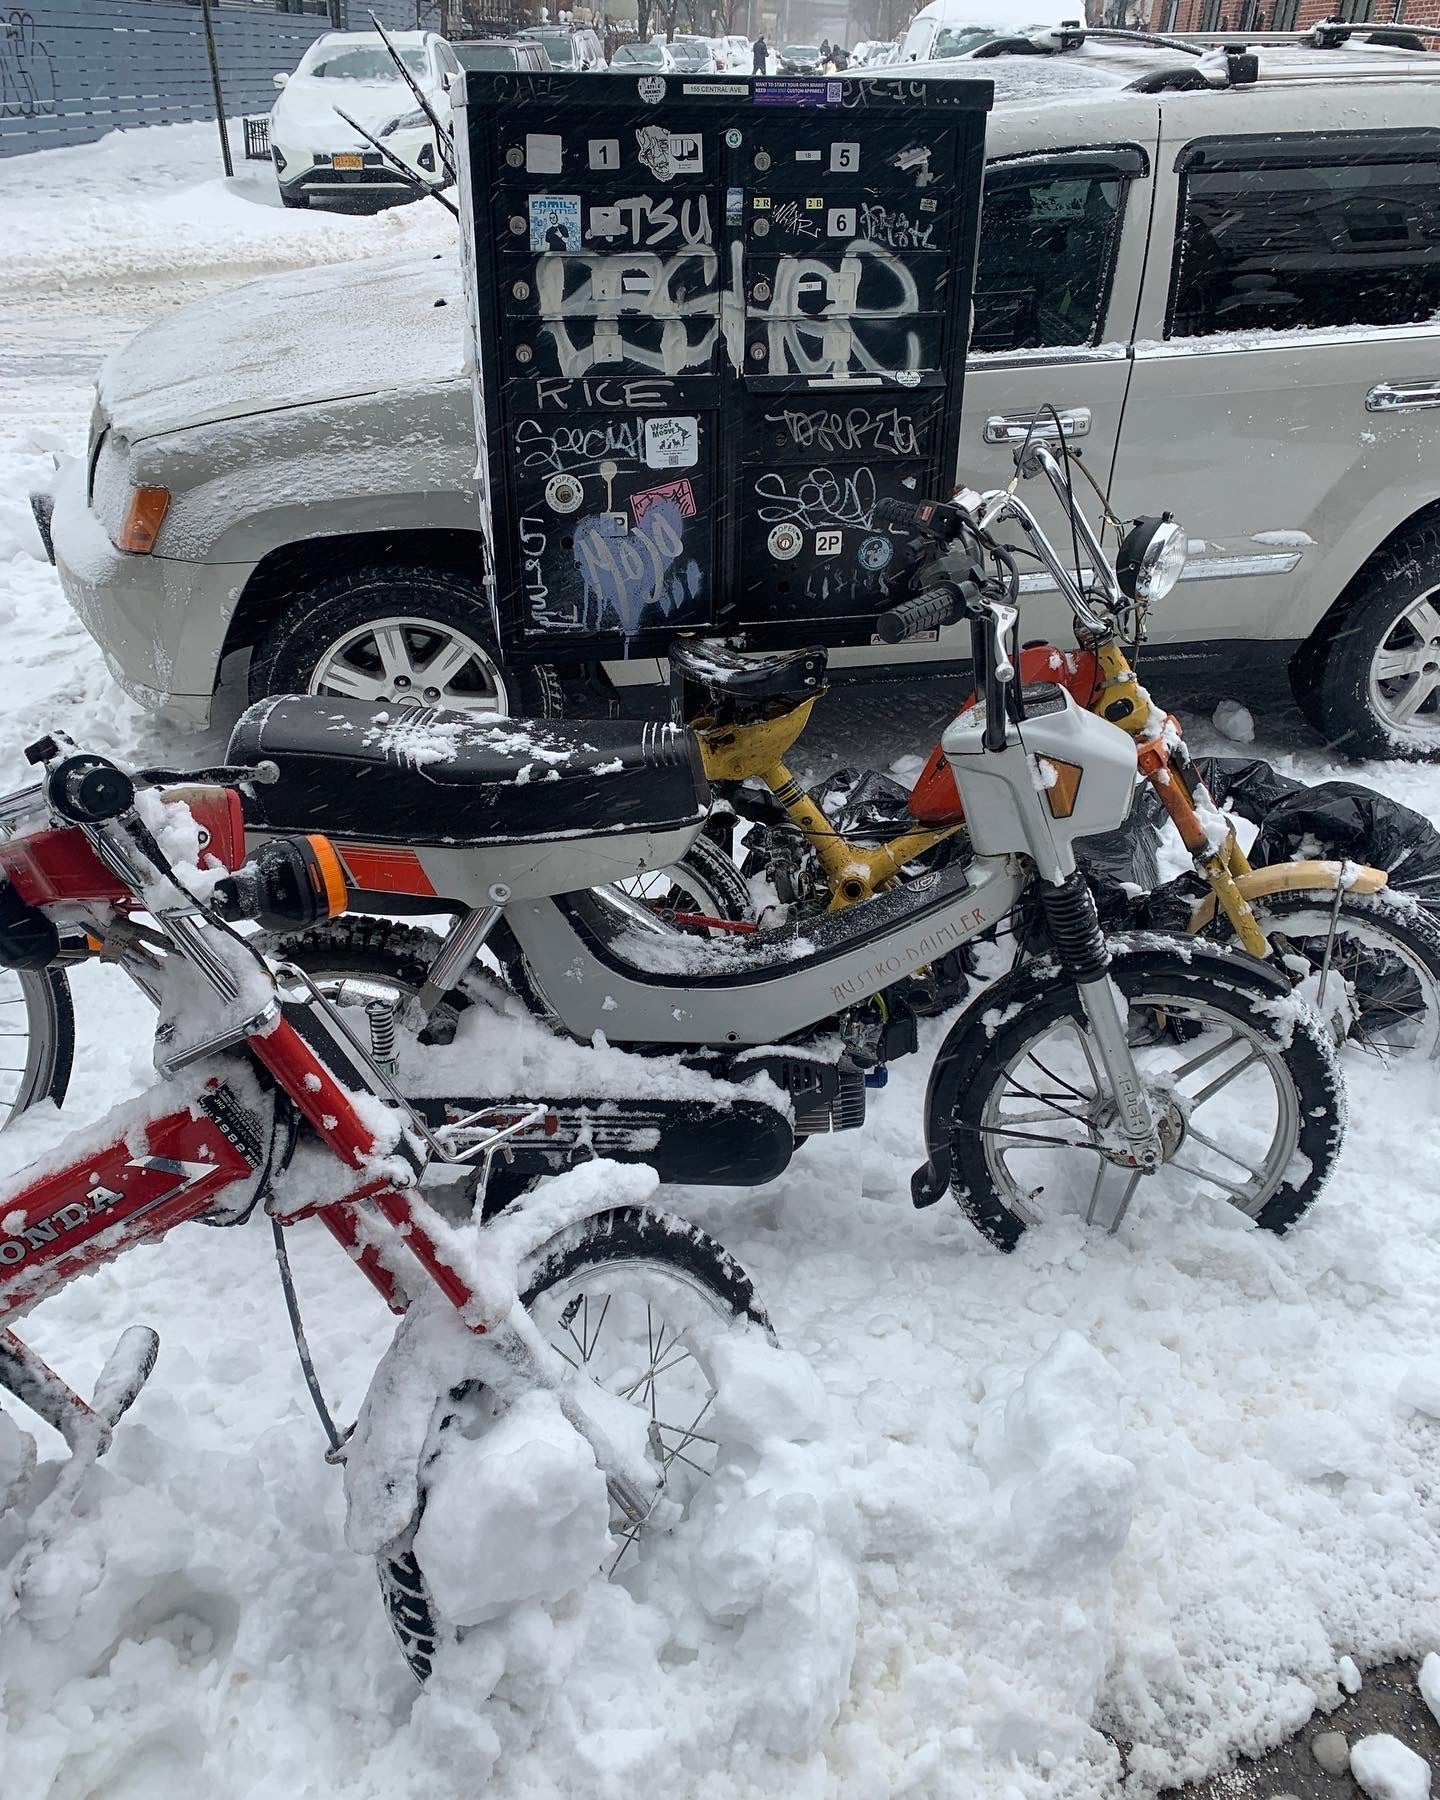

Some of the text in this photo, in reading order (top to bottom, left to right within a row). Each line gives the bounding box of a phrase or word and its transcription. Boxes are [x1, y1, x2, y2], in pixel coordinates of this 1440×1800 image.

[701, 85, 728, 93] CENTRAL
[730, 85, 742, 94] AVE
[600, 145, 607, 164] 1
[670, 139, 695, 157] UP
[839, 149, 850, 167] 5
[531, 201, 578, 209] FAMILY
[836, 214, 847, 231] 6
[650, 419, 673, 431] Woof
[556, 475, 577, 486] OPEN
[777, 524, 797, 535] OPEN
[817, 535, 840, 552] 2P
[214, 1114, 246, 1154] 1982
